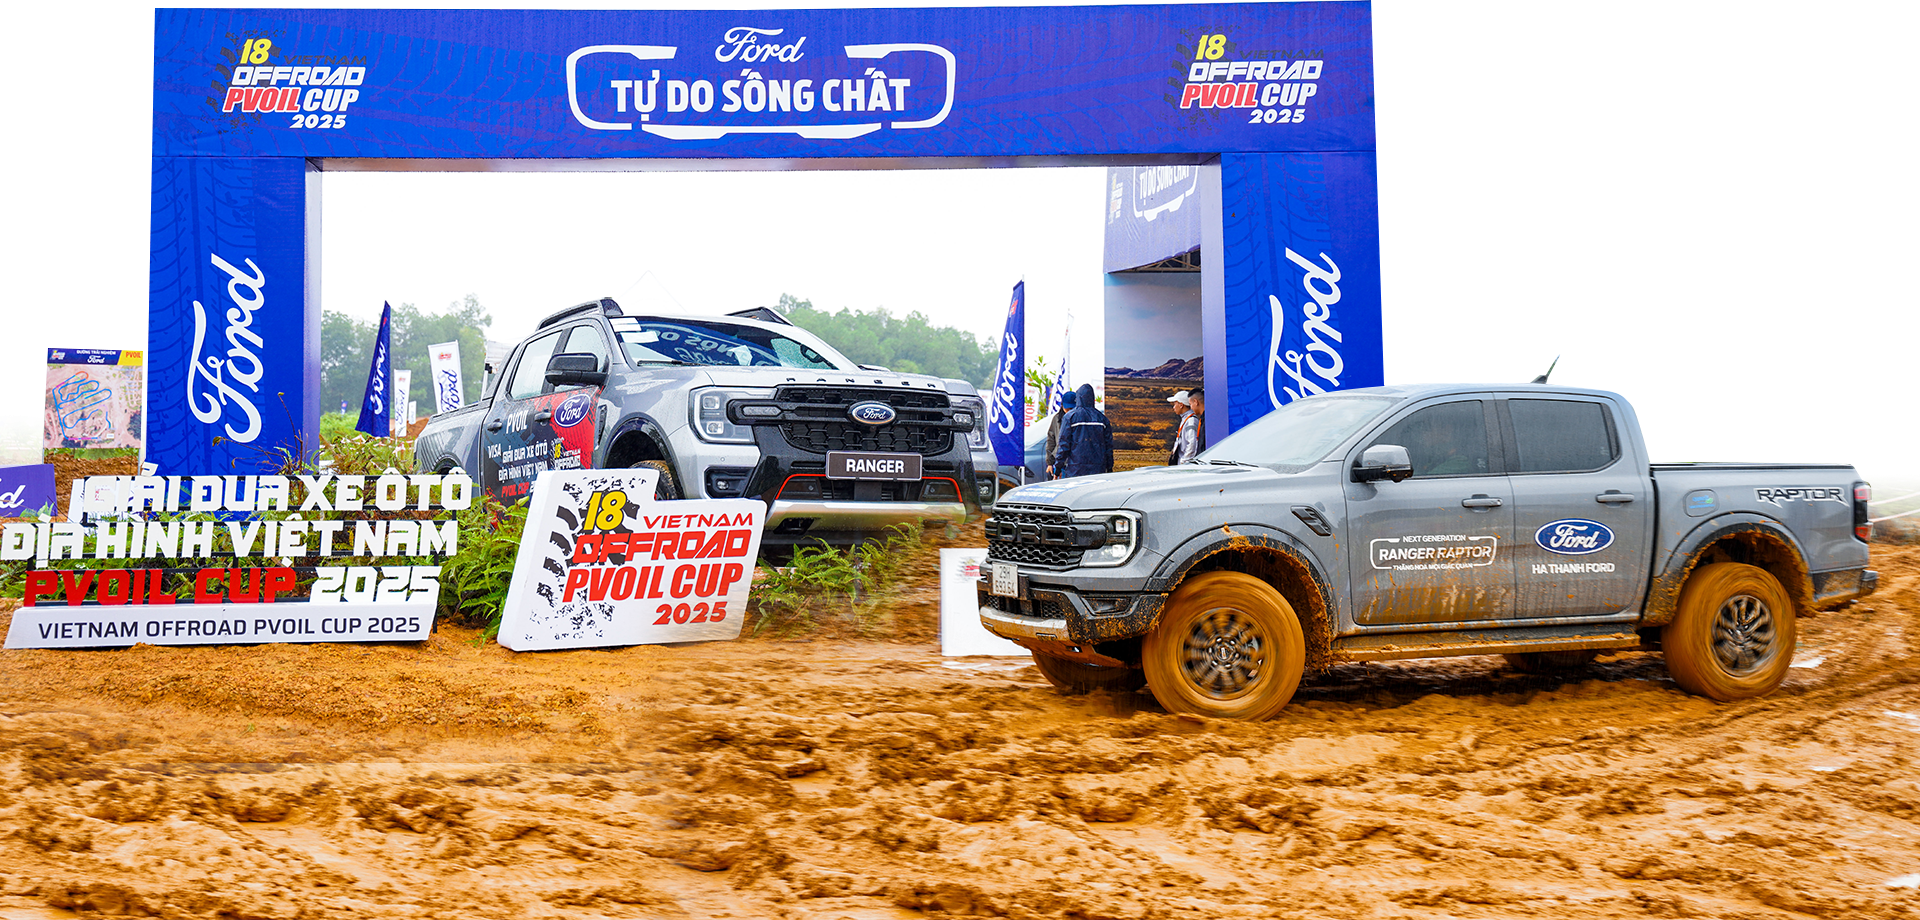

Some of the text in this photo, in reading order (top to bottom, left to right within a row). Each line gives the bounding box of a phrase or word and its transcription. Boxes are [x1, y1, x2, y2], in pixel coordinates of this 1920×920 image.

[240, 38, 272, 65] 18
[715, 26, 807, 63] Ford
[1195, 34, 1227, 60] 18
[1239, 49, 1325, 60] VIETNAM
[284, 54, 367, 65] VIETNAM
[1188, 60, 1323, 82] OFFROAD
[231, 66, 366, 86] OFFROAD
[222, 87, 360, 113] PVOIL CUP
[610, 67, 911, 121] TỰ DO SỐNG CHẤT
[1180, 82, 1318, 109] PVOIL CUP
[289, 114, 346, 129] 2025
[1248, 109, 1305, 124] 2025
[1268, 247, 1345, 411] Ford
[87, 355, 105, 364] Ford
[125, 351, 141, 359] PVOIL
[187, 253, 266, 443] Ford
[786, 377, 936, 388] RANGER
[991, 331, 1018, 435] Ford
[506, 410, 529, 434] PVOIL
[560, 398, 585, 422] Ford
[863, 407, 886, 420] Ford
[488, 443, 501, 459] VISA
[526, 445, 534, 458] XE
[845, 458, 905, 473] RANGER
[301, 475, 366, 511] XE
[1753, 487, 1850, 509] RAPTOR
[584, 491, 626, 531] 18
[643, 513, 753, 529] VIETNAM
[94, 513, 215, 560] HÌNH
[227, 512, 345, 567] VIỆT
[353, 520, 458, 557] NAM
[572, 530, 752, 563] OFFROAD
[1403, 534, 1466, 543] NEXT GENERATION
[1550, 523, 1601, 550] Ford
[1379, 546, 1492, 561] RANGER RAPTOR
[1532, 562, 1615, 574] HA THANH FORD
[24, 566, 443, 607] PVOIL CUP 2025
[562, 563, 744, 603] PVOIL CUP
[652, 601, 728, 626] 2025
[38, 616, 421, 640] VIETNAM OFFROAD PVOIL CUP 2025
